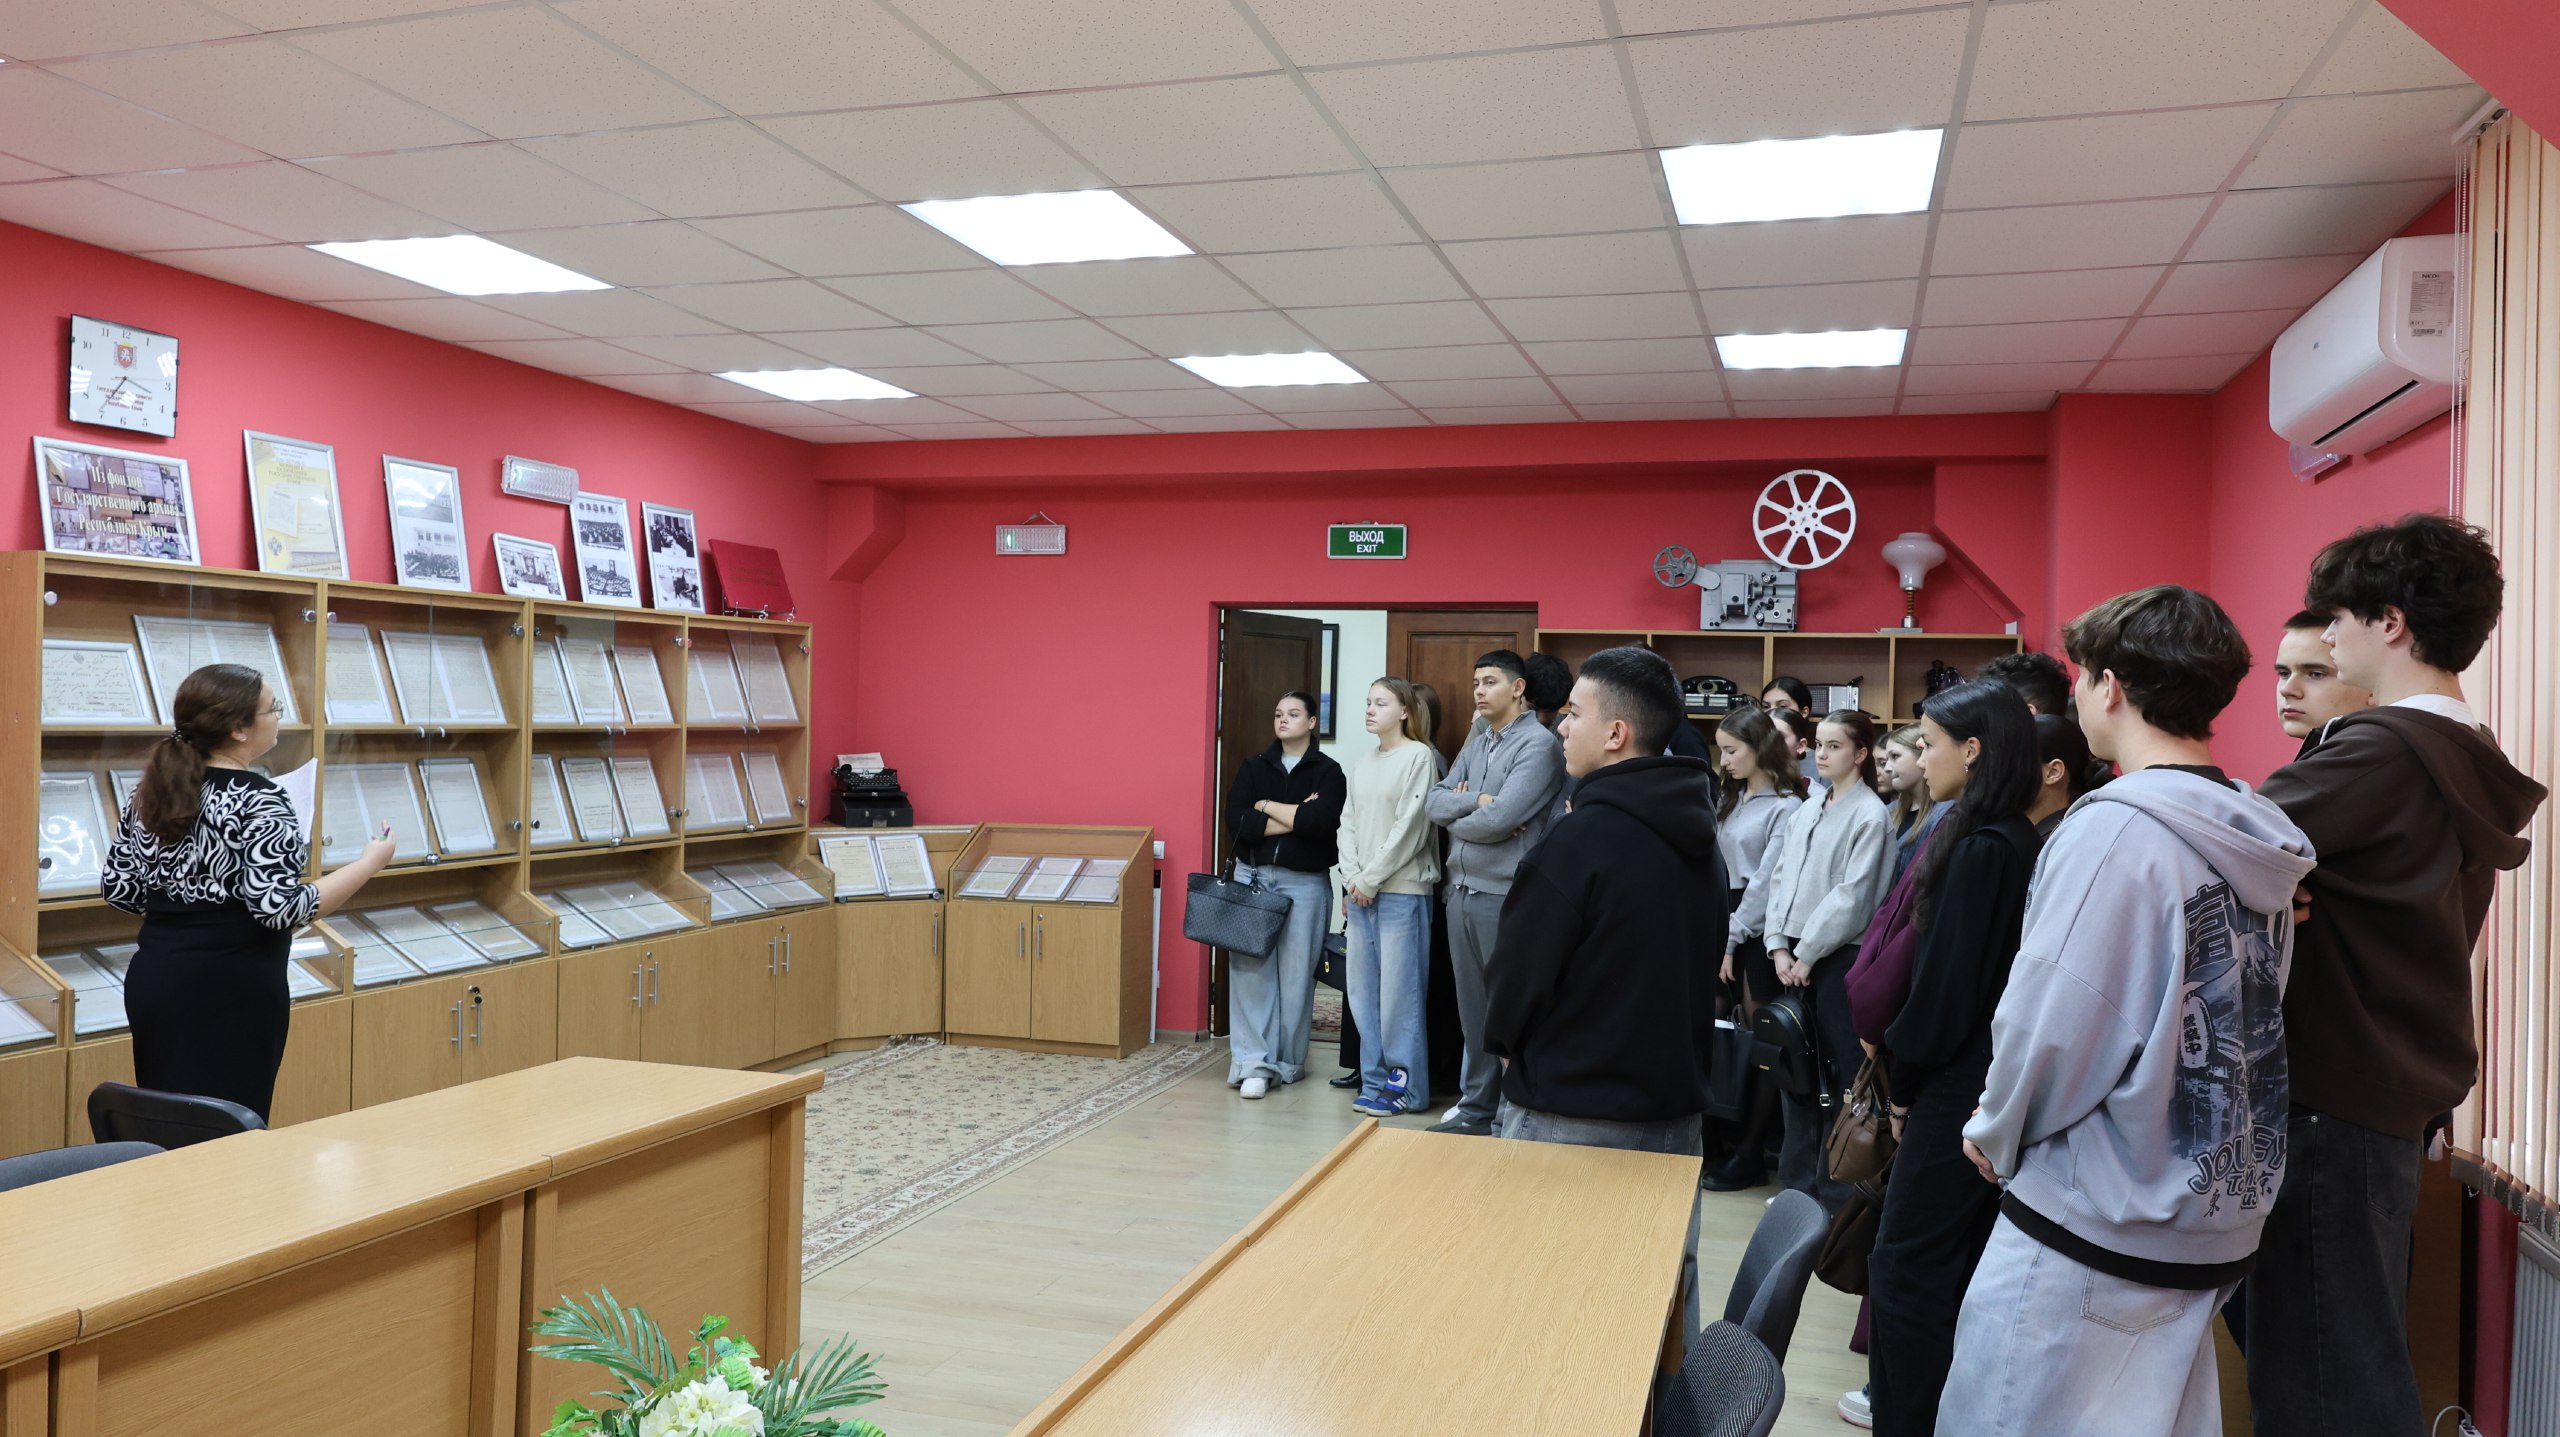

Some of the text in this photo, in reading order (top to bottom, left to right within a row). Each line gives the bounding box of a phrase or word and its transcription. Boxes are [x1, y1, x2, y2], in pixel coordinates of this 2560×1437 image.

[101, 327, 110, 338] 11
[122, 329, 132, 340] 12
[83, 340, 92, 350] 10
[165, 382, 171, 391] 3
[83, 391, 90, 399] 8
[120, 416, 127, 425] 6
[142, 418, 148, 427] 5
[91, 466, 144, 489] Из фондов
[55, 485, 180, 519] Государственного архива
[79, 513, 169, 541] Республики Крым
[1349, 530, 1384, 544] ВЫХОД
[1357, 544, 1378, 553] EXIT
